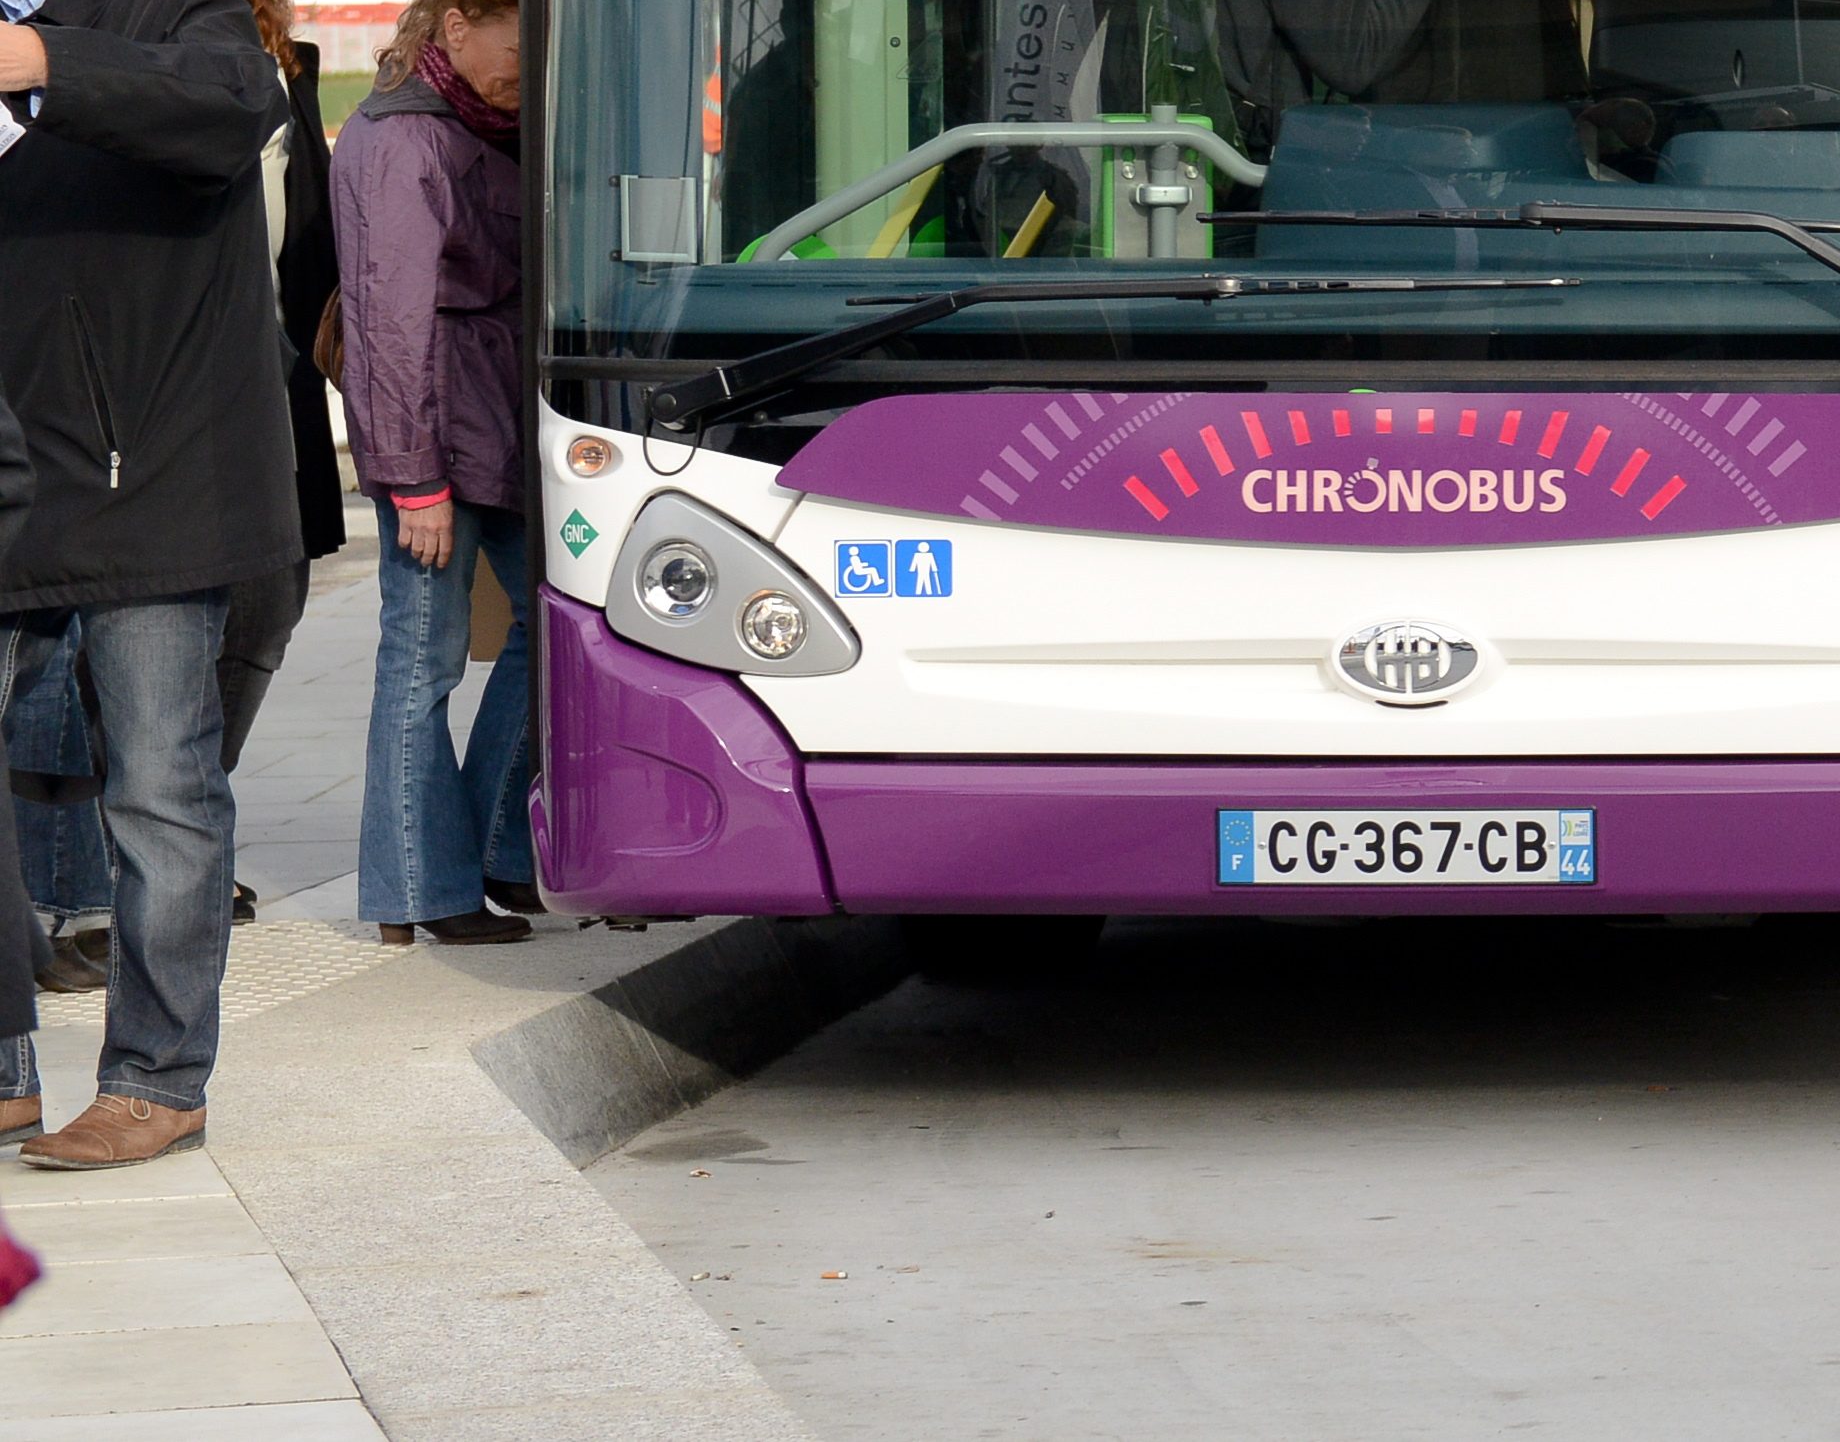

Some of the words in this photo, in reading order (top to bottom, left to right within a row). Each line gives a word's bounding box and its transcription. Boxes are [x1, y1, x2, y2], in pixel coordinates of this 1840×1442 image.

[1001, 4, 1047, 124] antes
[1241, 467, 1568, 513] CHRONOBUS
[564, 523, 590, 544] GNC
[1231, 853, 1244, 871] F
[1267, 820, 1548, 874] CG-367-CB
[1560, 848, 1591, 876] 44
